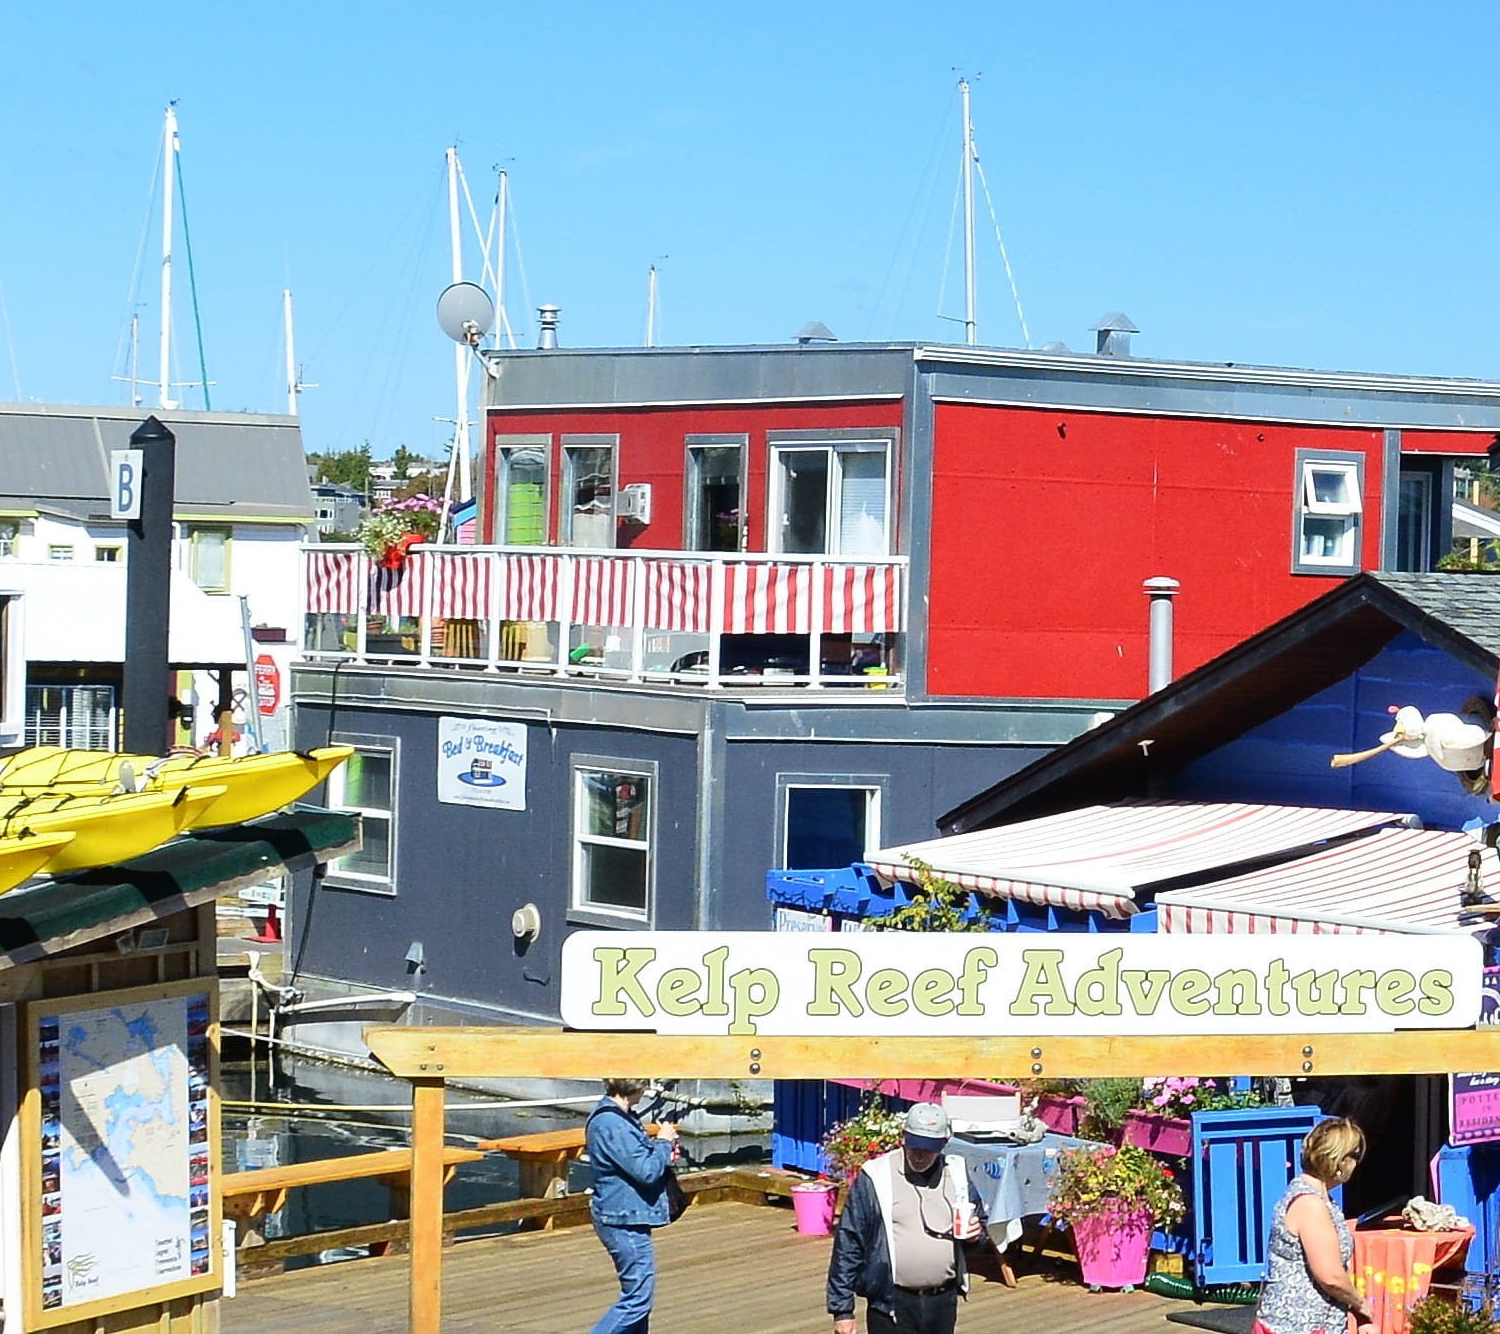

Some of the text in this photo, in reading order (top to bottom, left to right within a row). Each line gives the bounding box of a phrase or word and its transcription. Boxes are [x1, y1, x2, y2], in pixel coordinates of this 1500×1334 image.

[118, 463, 134, 512] B
[442, 736, 464, 758] Bed
[473, 734, 524, 767] Breakfast
[592, 945, 1456, 1037] Kelp Reef Adventures
